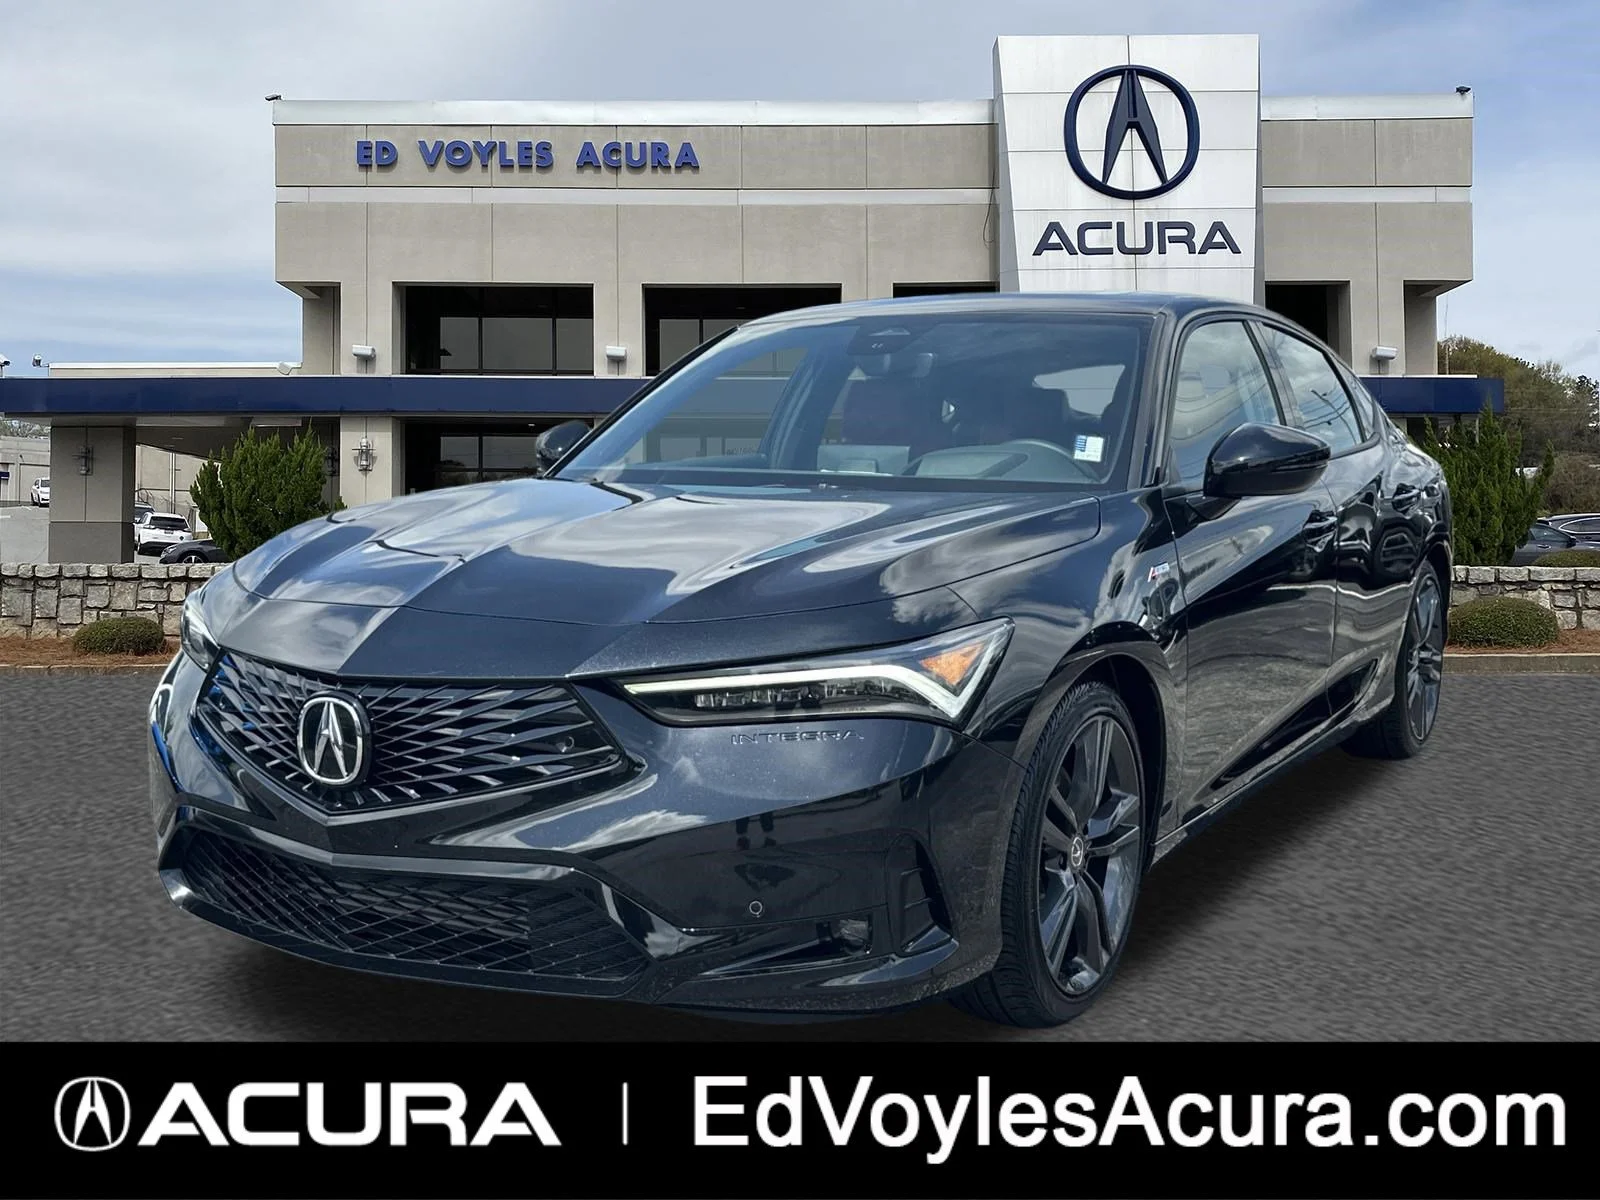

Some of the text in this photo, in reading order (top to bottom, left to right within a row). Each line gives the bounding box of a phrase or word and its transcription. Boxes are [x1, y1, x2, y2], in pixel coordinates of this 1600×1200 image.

[355, 140, 699, 168] ED VOYLES ACURA
[1032, 221, 1242, 256] ACURA
[730, 730, 865, 745] INTEGRA
